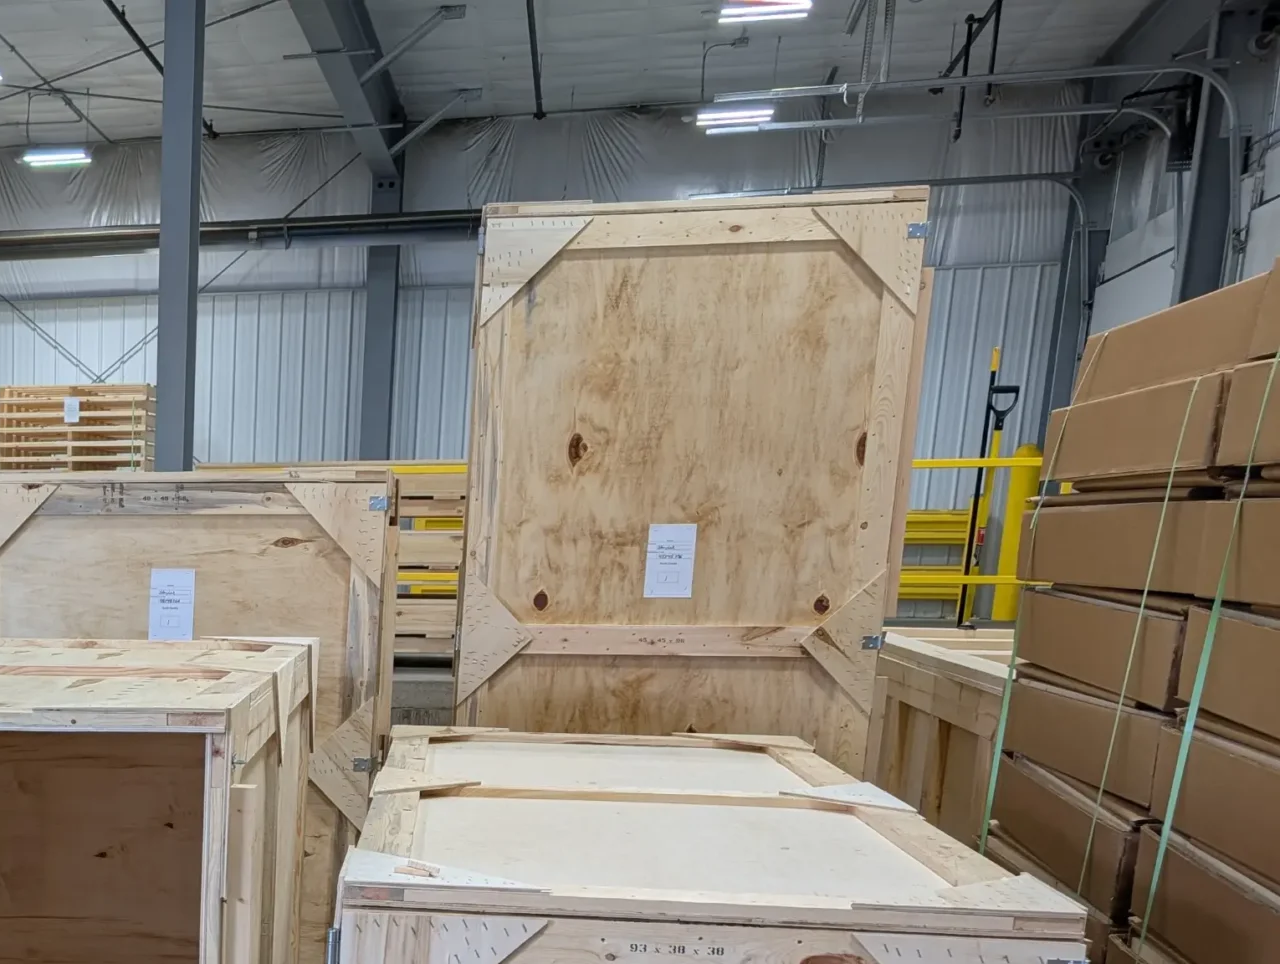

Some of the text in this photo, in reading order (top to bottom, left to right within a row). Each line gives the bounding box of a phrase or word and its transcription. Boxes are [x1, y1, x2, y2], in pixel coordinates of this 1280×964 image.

[629, 943, 725, 957] 93 x 38 x 38
